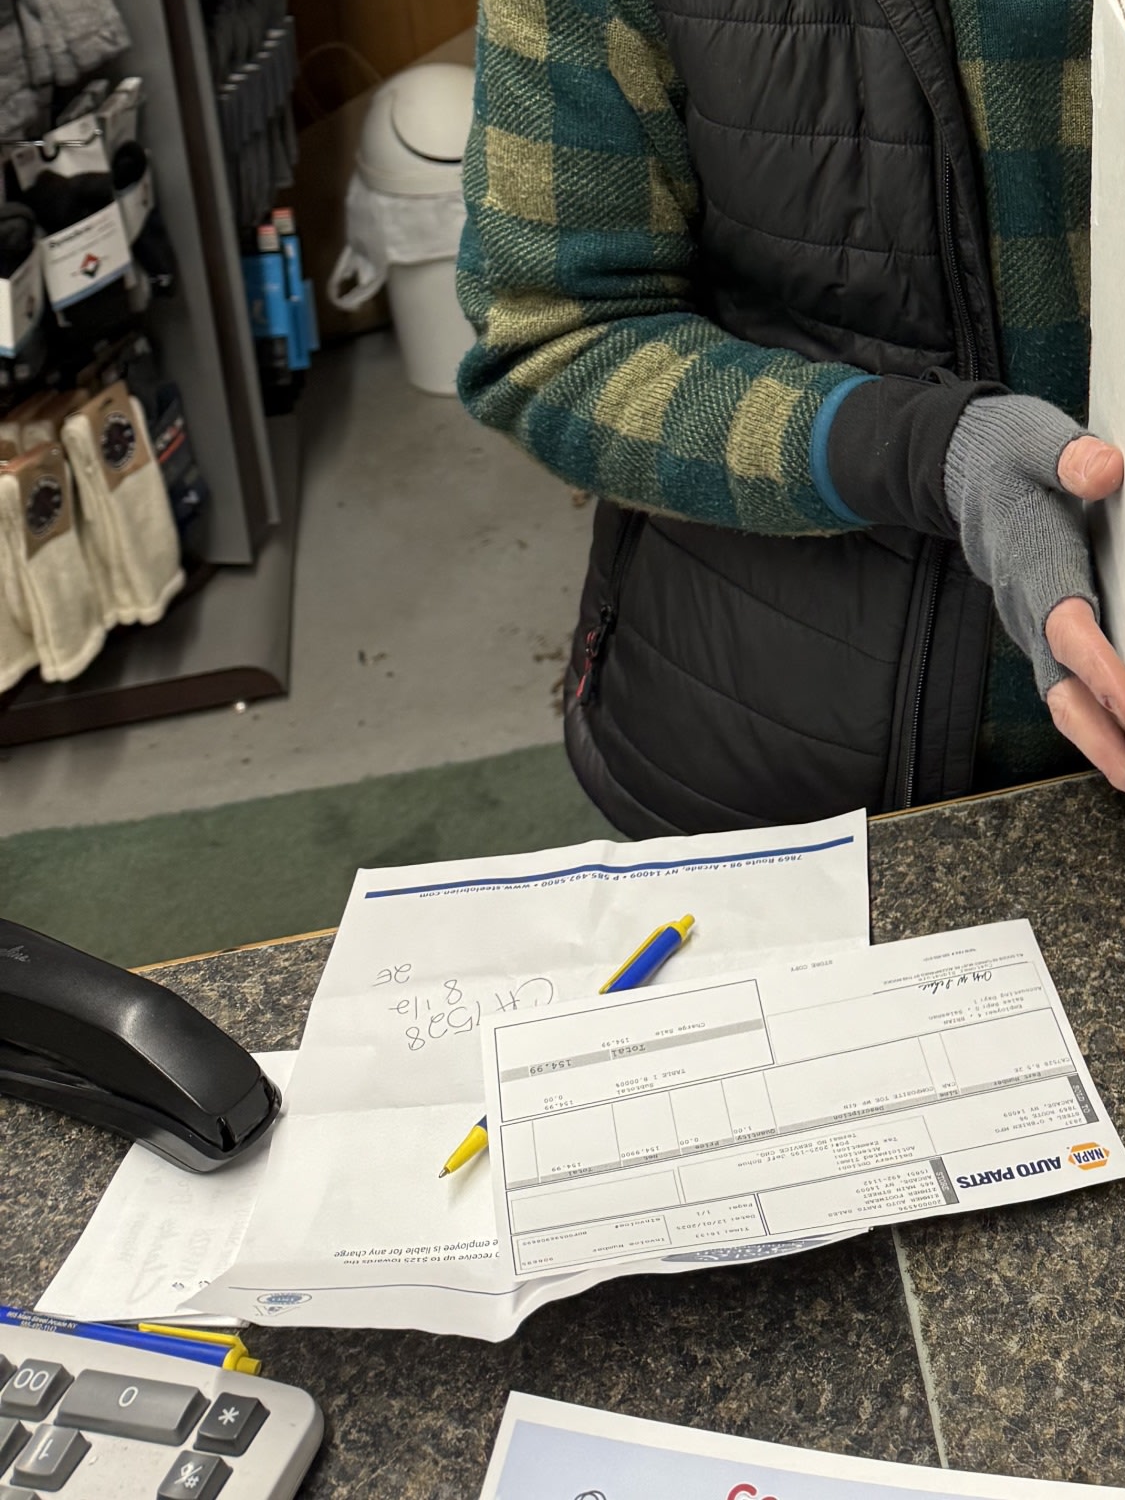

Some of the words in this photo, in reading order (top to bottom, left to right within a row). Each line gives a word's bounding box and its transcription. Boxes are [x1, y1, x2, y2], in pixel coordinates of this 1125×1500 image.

[745, 856, 775, 867] Route
[777, 854, 802, 862] 7869
[629, 870, 661, 880] 14009
[665, 868, 679, 877] NY
[419, 883, 531, 899] www.steelobrien.com
[528, 1058, 573, 1076] 154.99
[609, 1042, 647, 1058] Total
[1072, 1148, 1105, 1164] NAPA
[1016, 1155, 1062, 1178] AUTO
[955, 1166, 1013, 1189] PARTS
[405, 1245, 432, 1256] liable
[433, 1244, 442, 1252] is
[443, 1238, 491, 1252] employee
[333, 1247, 367, 1259] charge
[369, 1246, 387, 1257] any
[390, 1248, 403, 1257] for
[458, 1251, 493, 1262] receive
[442, 1253, 456, 1262] up
[13, 1368, 49, 1391] 00
[118, 1386, 138, 1407] 0
